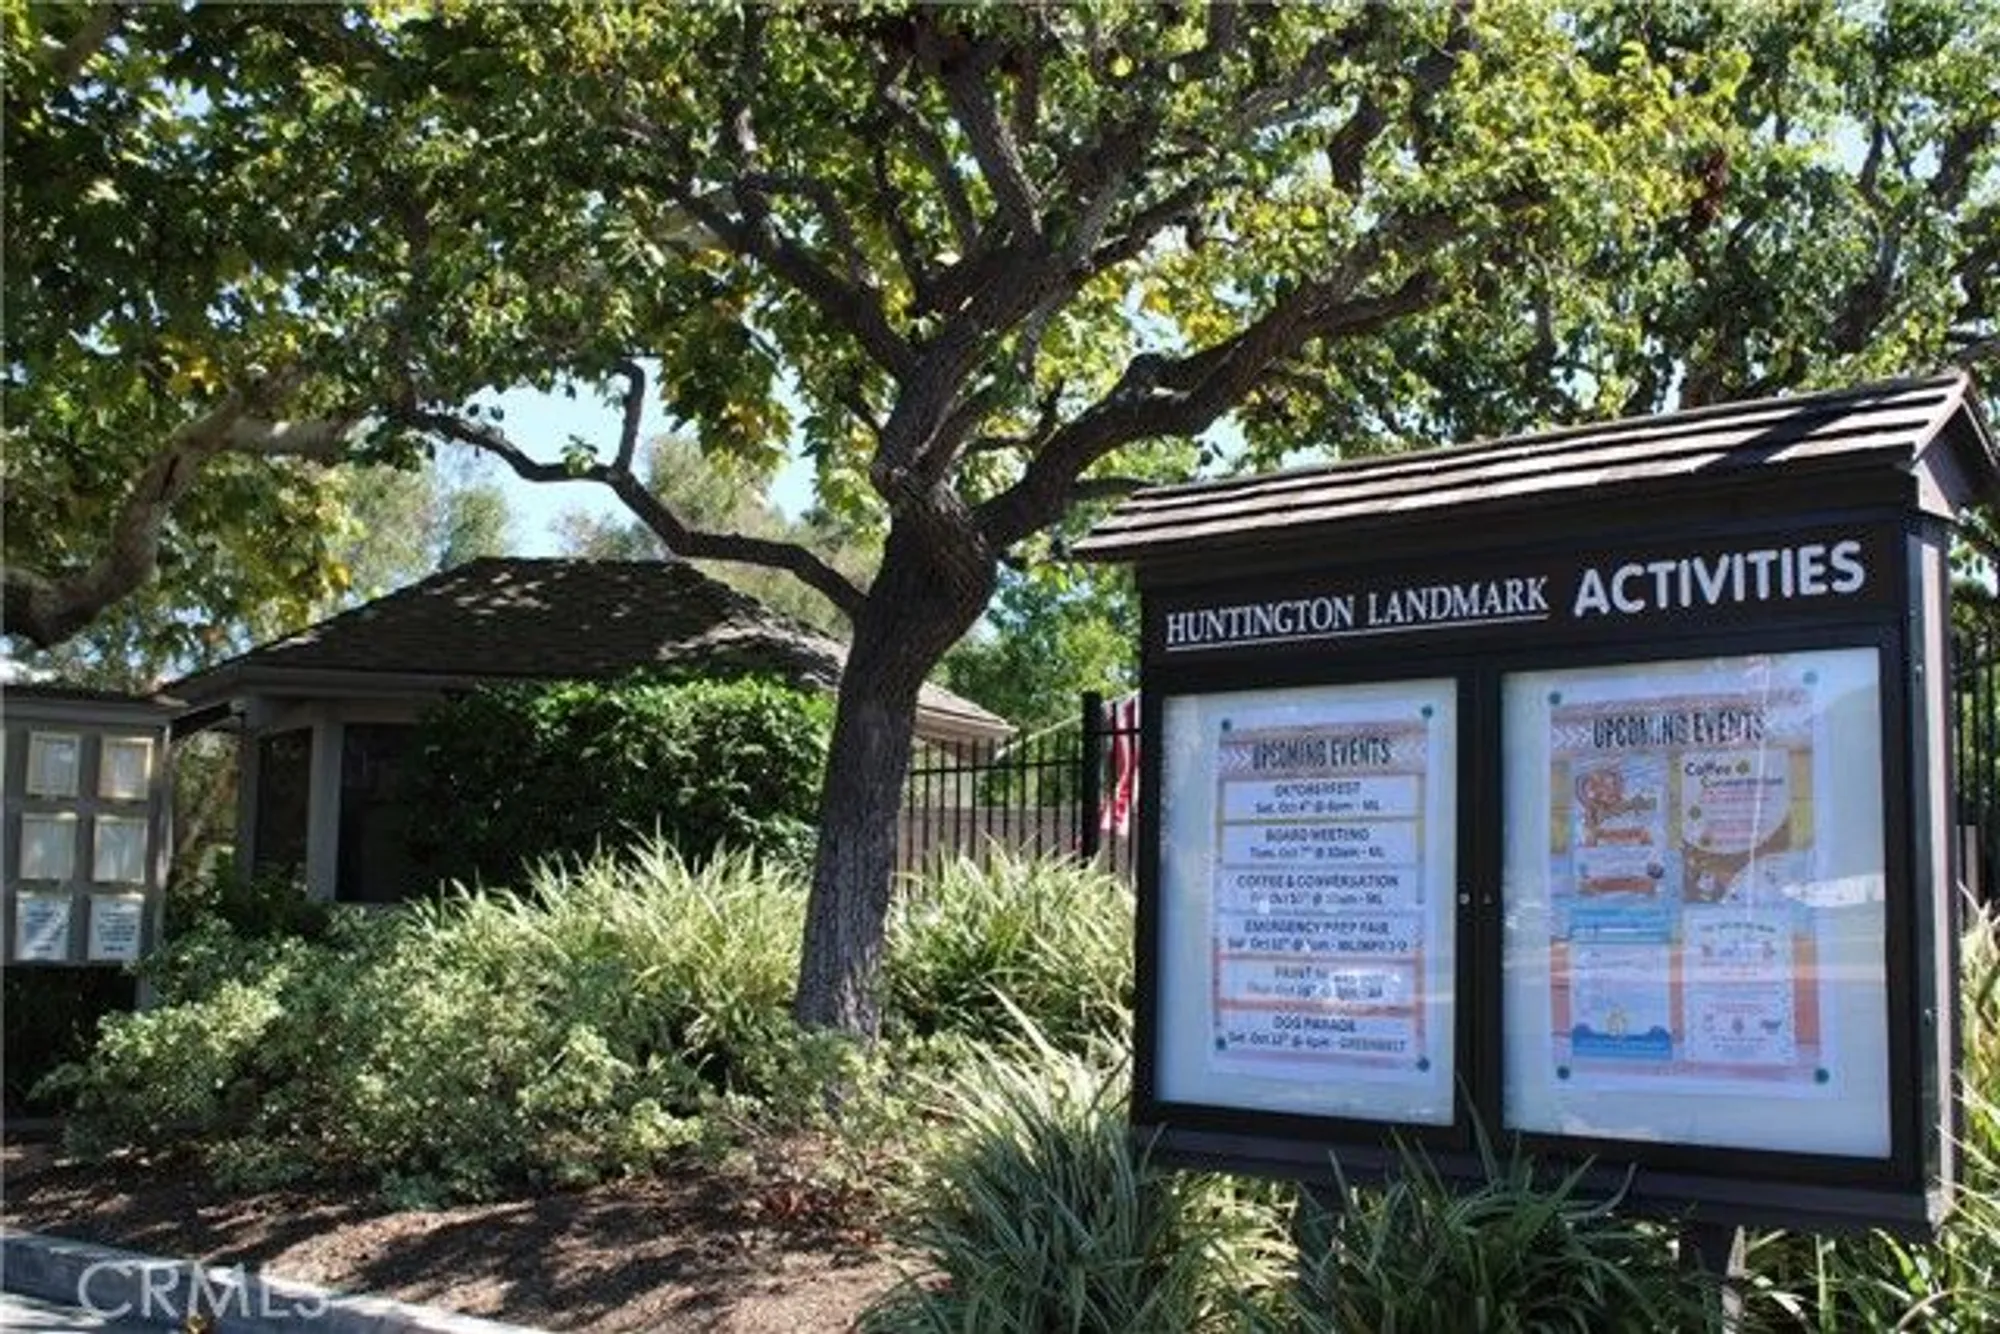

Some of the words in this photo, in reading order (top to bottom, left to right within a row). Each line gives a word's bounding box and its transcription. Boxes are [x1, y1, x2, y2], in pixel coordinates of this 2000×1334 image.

[1166, 594, 1355, 645] HUNTINGTON
[1367, 575, 1549, 626] LANDMARK
[1573, 540, 1866, 617] ACTIVITIES
[1592, 714, 1688, 749] UPCOMING
[1693, 708, 1765, 743] EVENTS
[1253, 737, 1326, 770] UPCOMING
[1331, 735, 1392, 767] EVENTS
[1684, 761, 1732, 777] Coffee
[1265, 828, 1308, 843] BOARD
[1310, 827, 1370, 843] MEETING
[1236, 874, 1283, 889] COFFEE
[1286, 874, 1296, 889] &
[1298, 874, 1400, 889] CONVERSATION
[1243, 918, 1320, 934] EMERGENCY
[1273, 1016, 1301, 1031] DOG
[1303, 1018, 1355, 1033] PARADE
